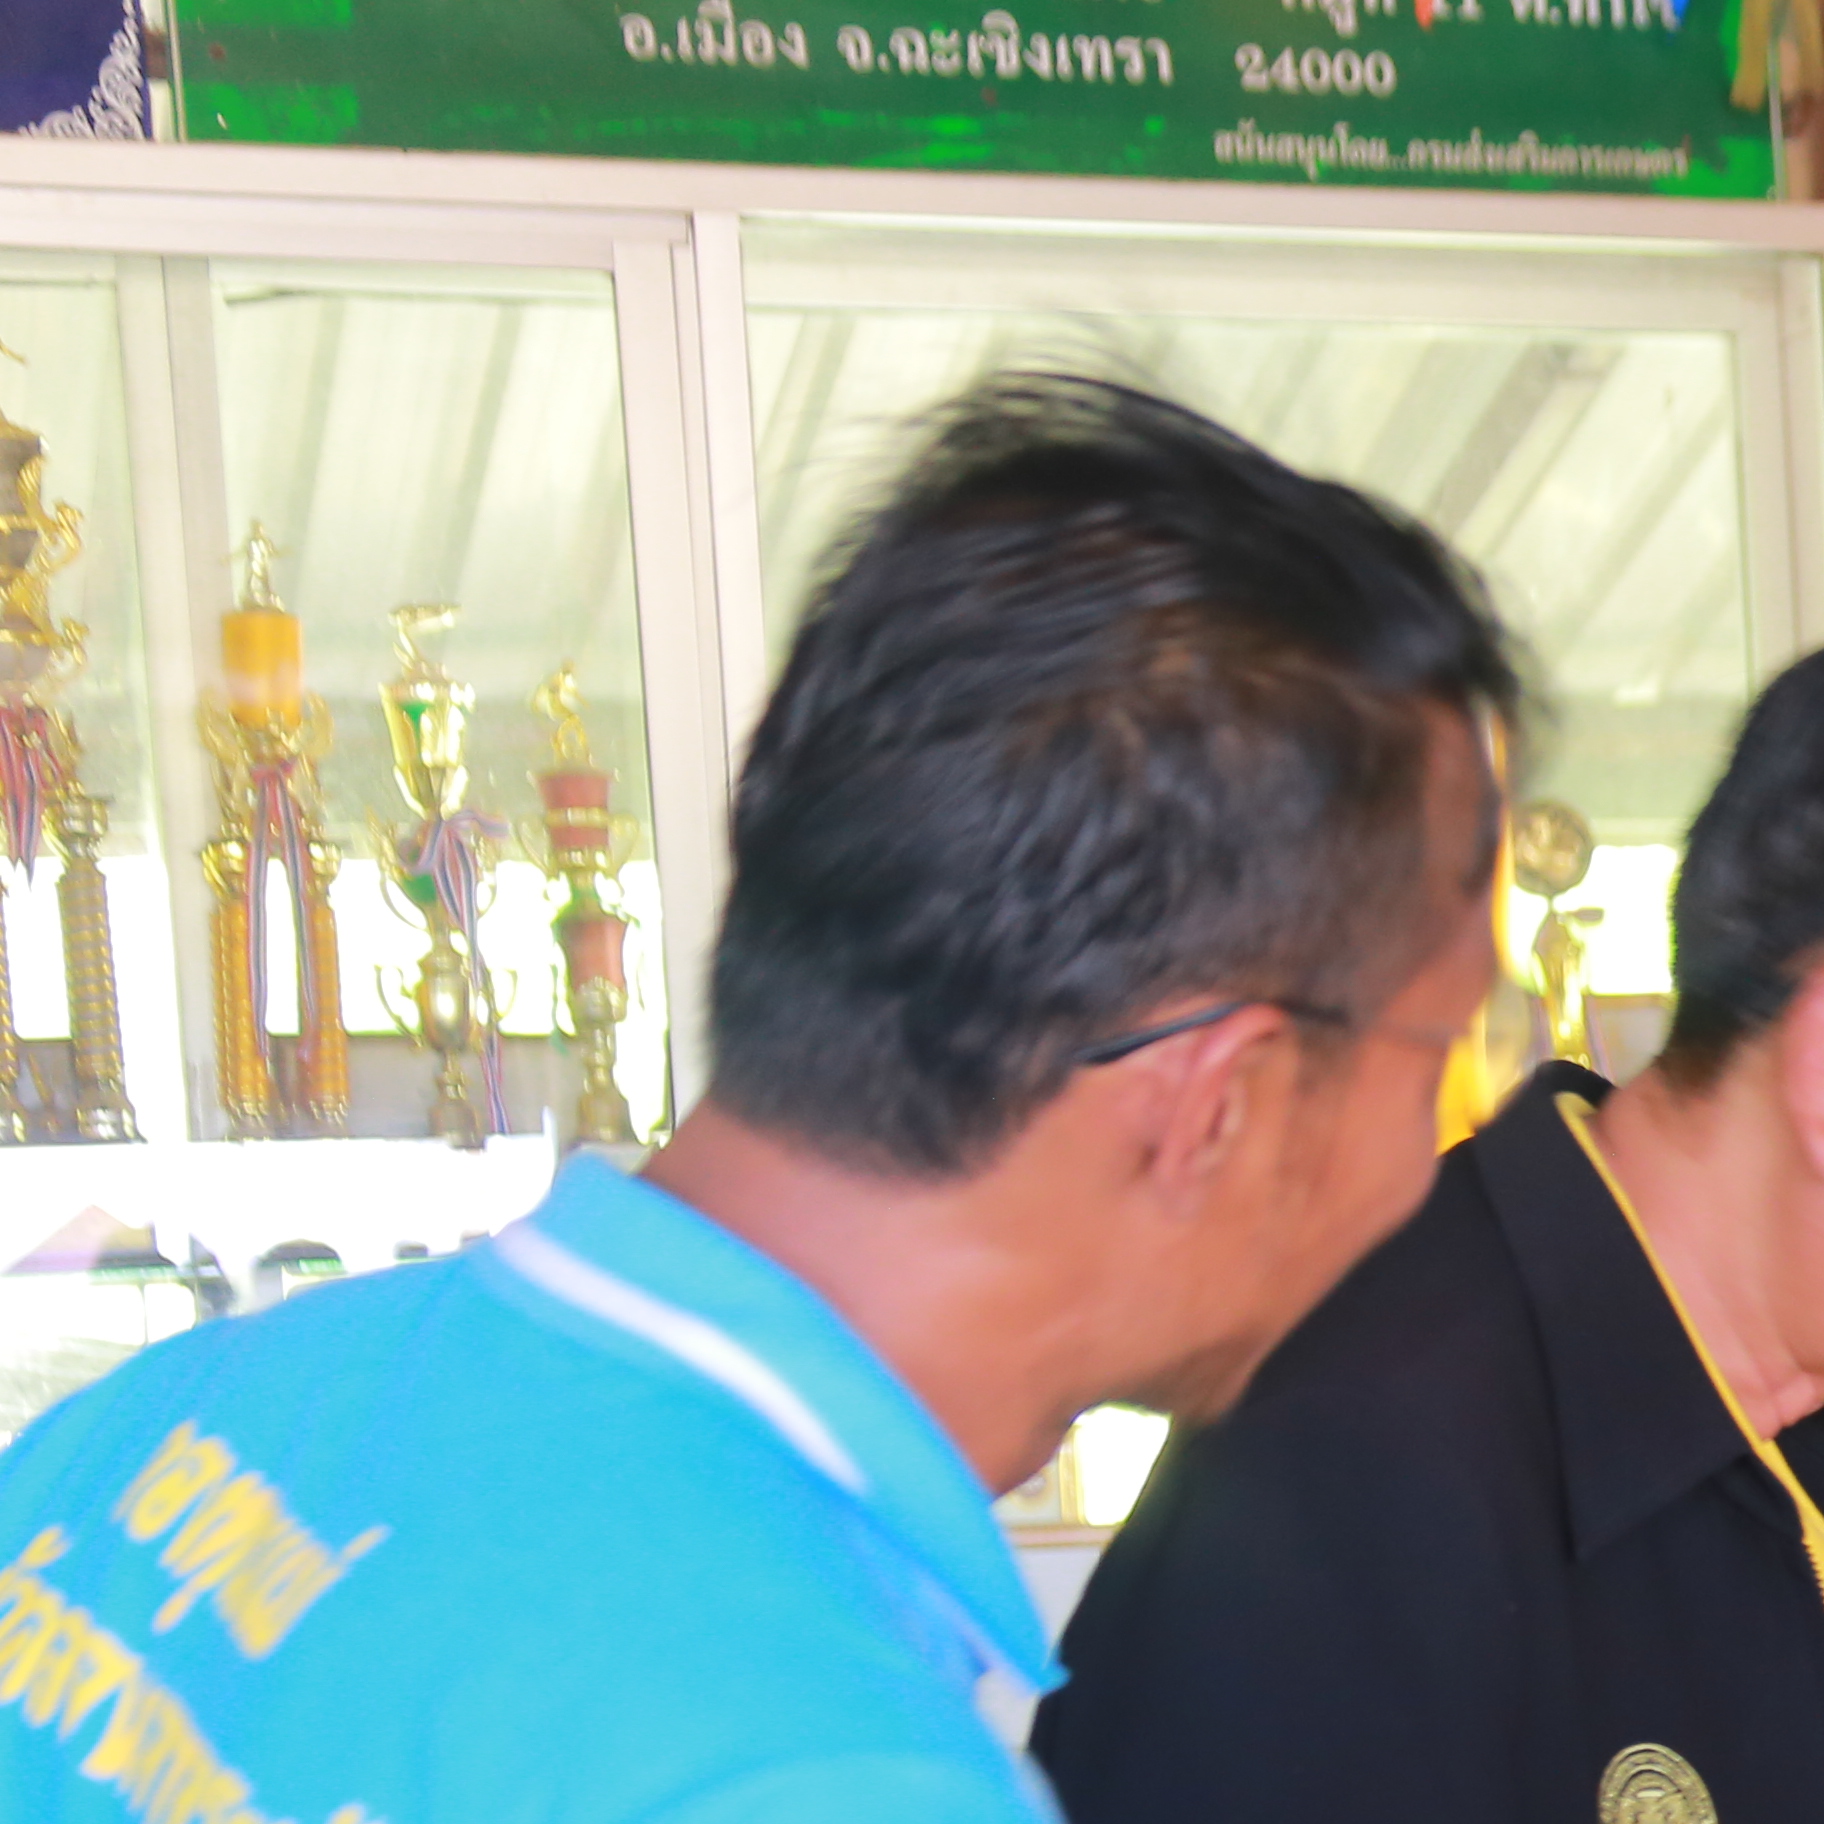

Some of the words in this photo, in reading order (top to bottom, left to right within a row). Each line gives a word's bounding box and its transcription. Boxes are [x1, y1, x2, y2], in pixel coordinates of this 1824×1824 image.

[617, 0, 809, 69] อ.เมือง
[838, 10, 1174, 87] จ.ฉะเชิงเทรา
[1235, 43, 1397, 97] 24000
